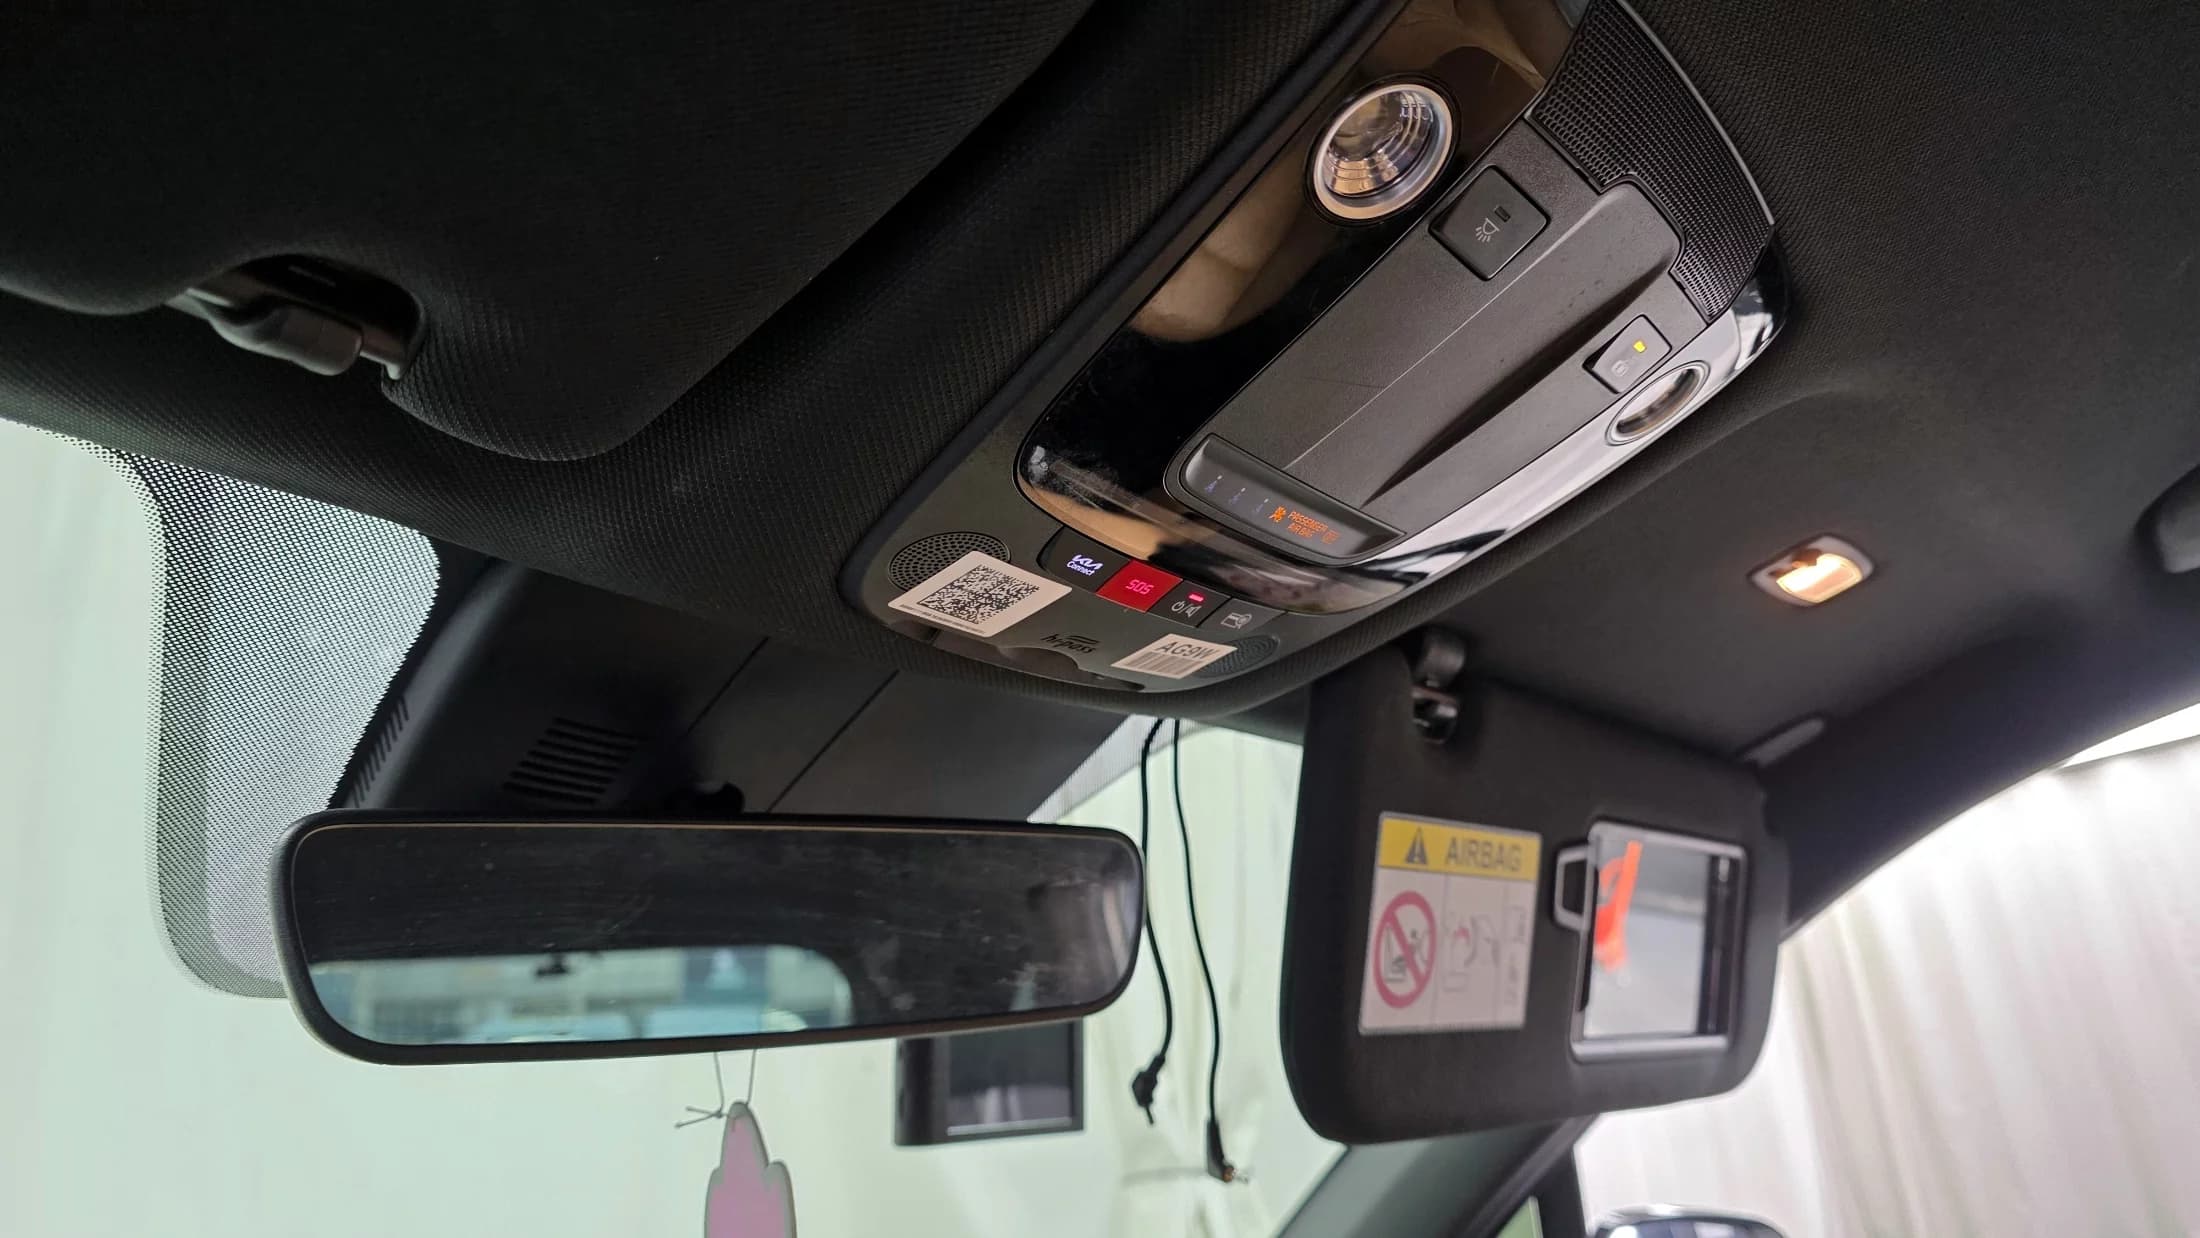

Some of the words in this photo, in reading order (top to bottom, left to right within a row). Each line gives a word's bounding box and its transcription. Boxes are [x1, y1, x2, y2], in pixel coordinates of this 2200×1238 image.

[1066, 561, 1095, 576] Connect
[1125, 579, 1155, 595] SOS
[1444, 836, 1523, 872] AIRBAG
